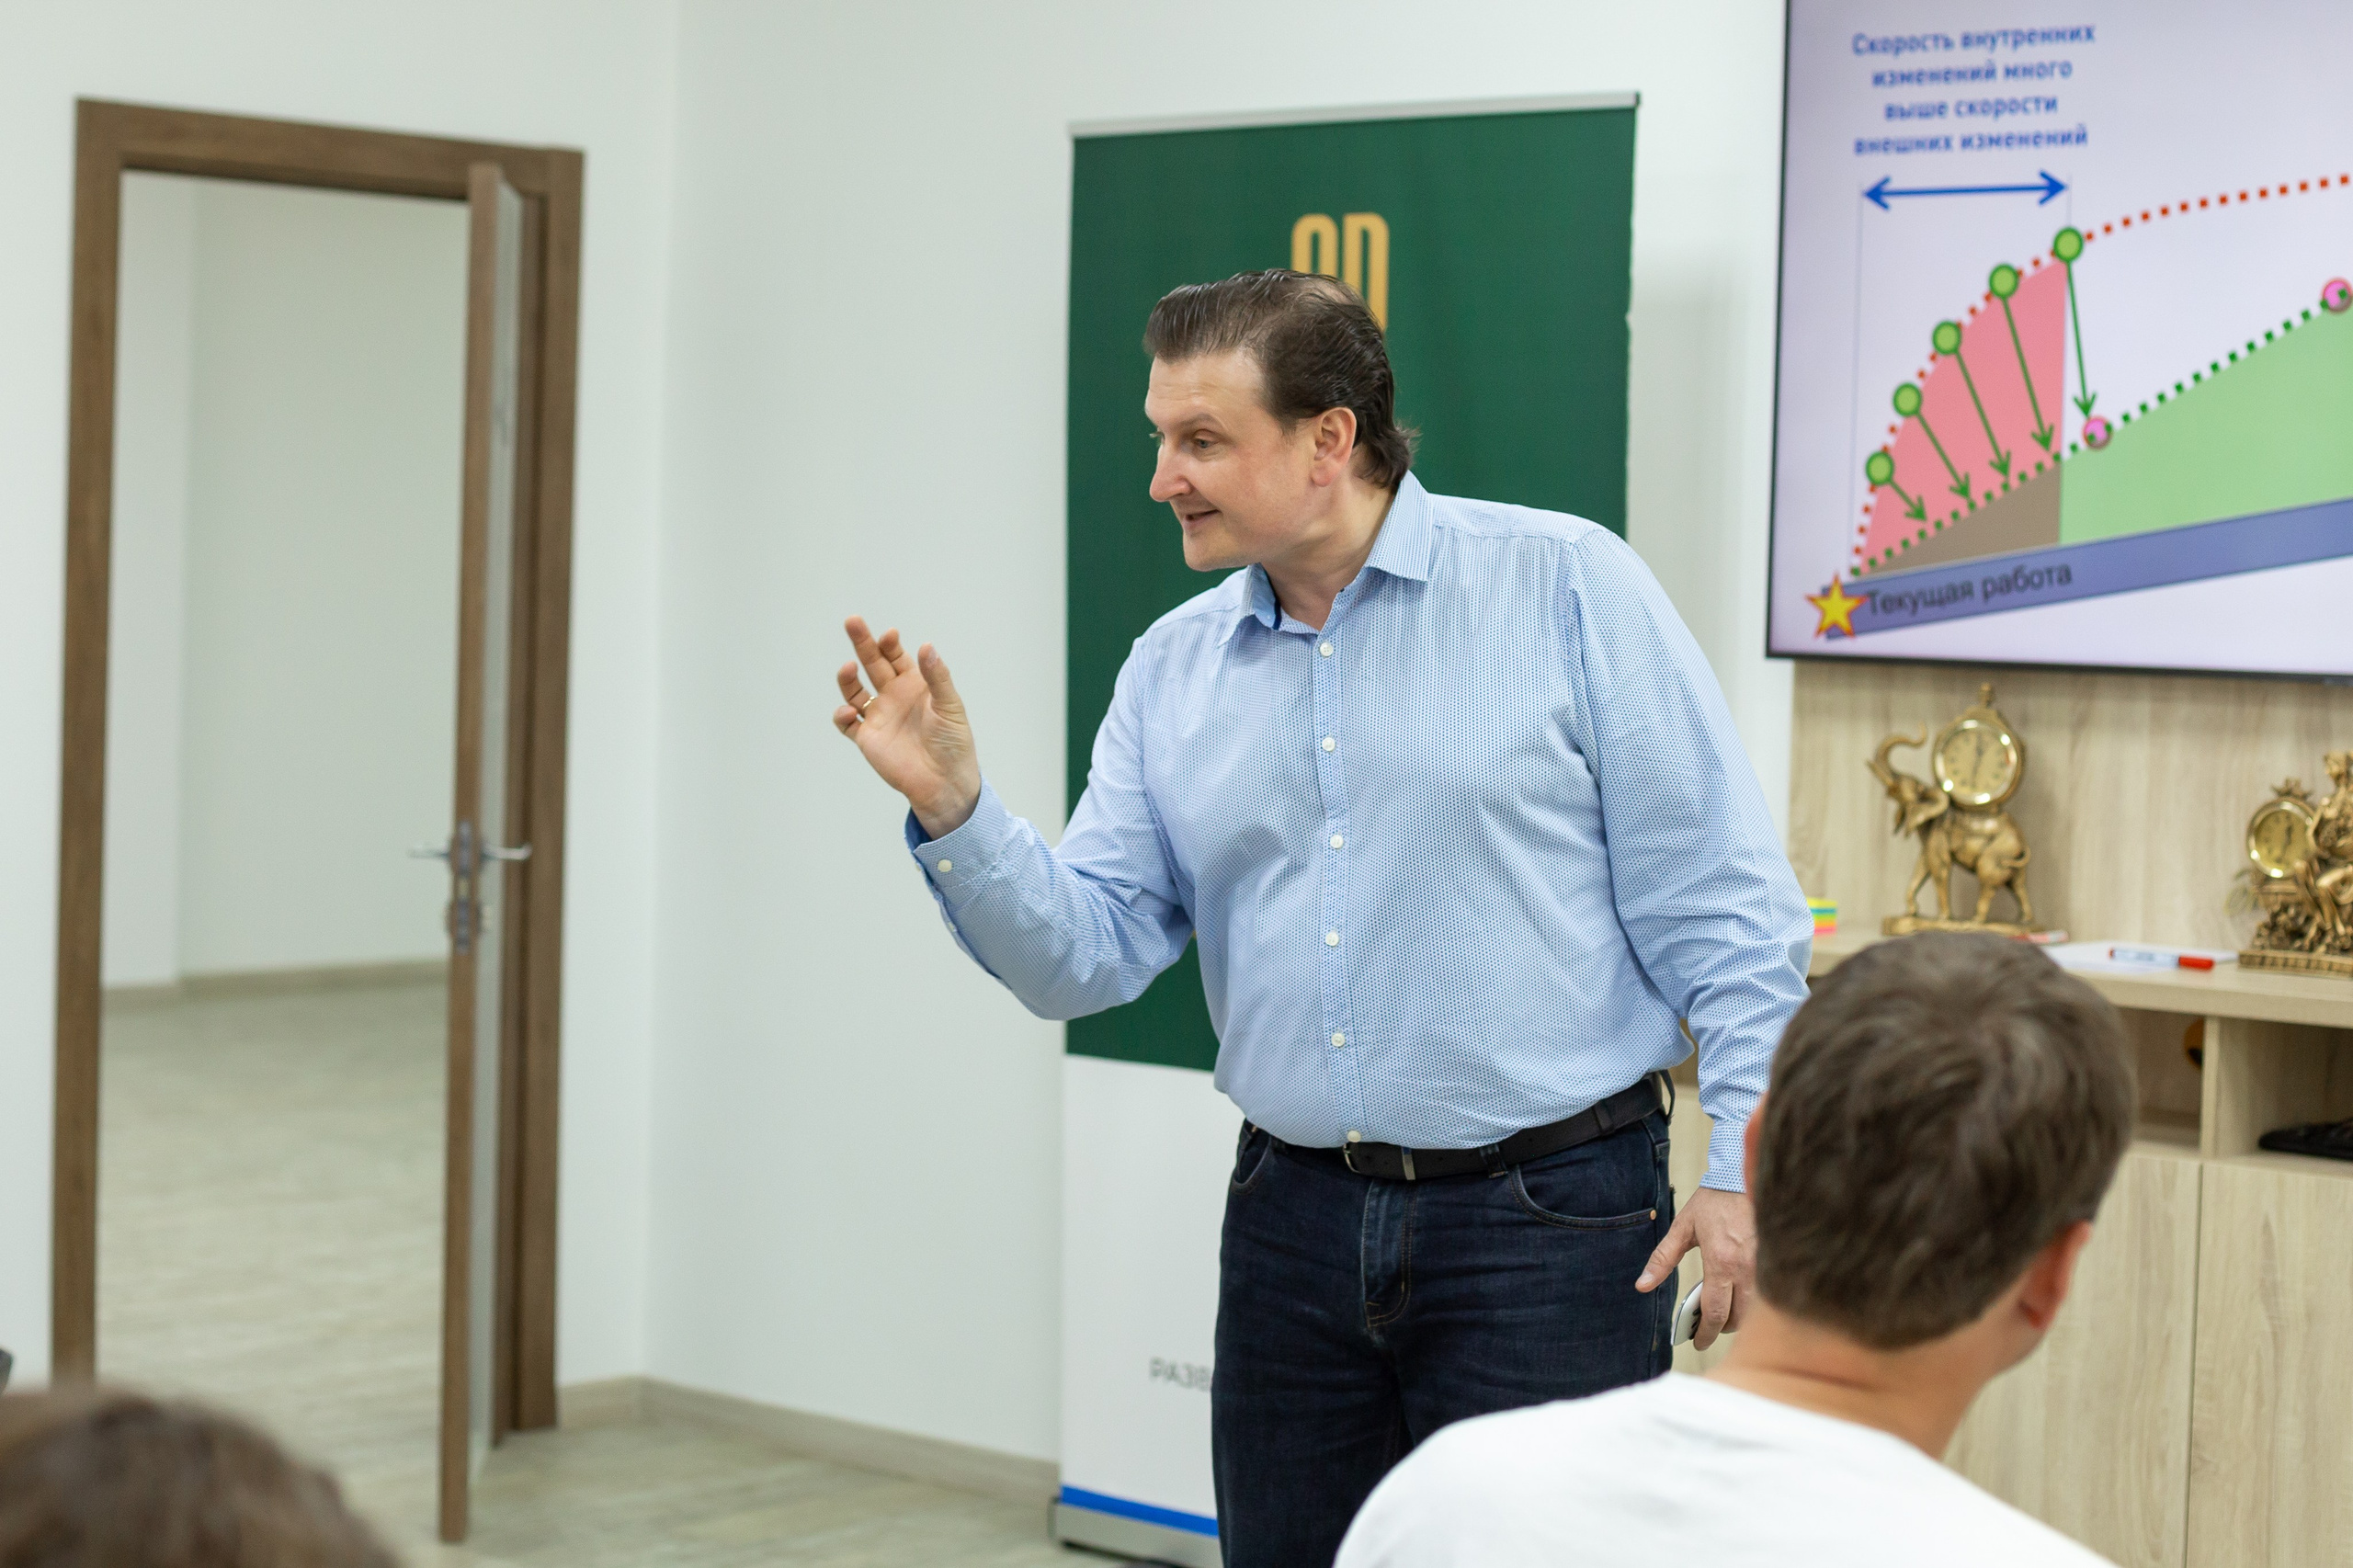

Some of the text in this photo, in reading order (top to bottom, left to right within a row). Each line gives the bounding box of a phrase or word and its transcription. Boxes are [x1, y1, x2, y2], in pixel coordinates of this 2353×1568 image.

[1852, 26, 2096, 57] Скорость внутренних
[1871, 60, 2073, 87] изменений много
[1885, 96, 2058, 120] выше скорости
[1854, 123, 2088, 155] внешних изменений
[1866, 562, 2073, 616] Текущая работа
